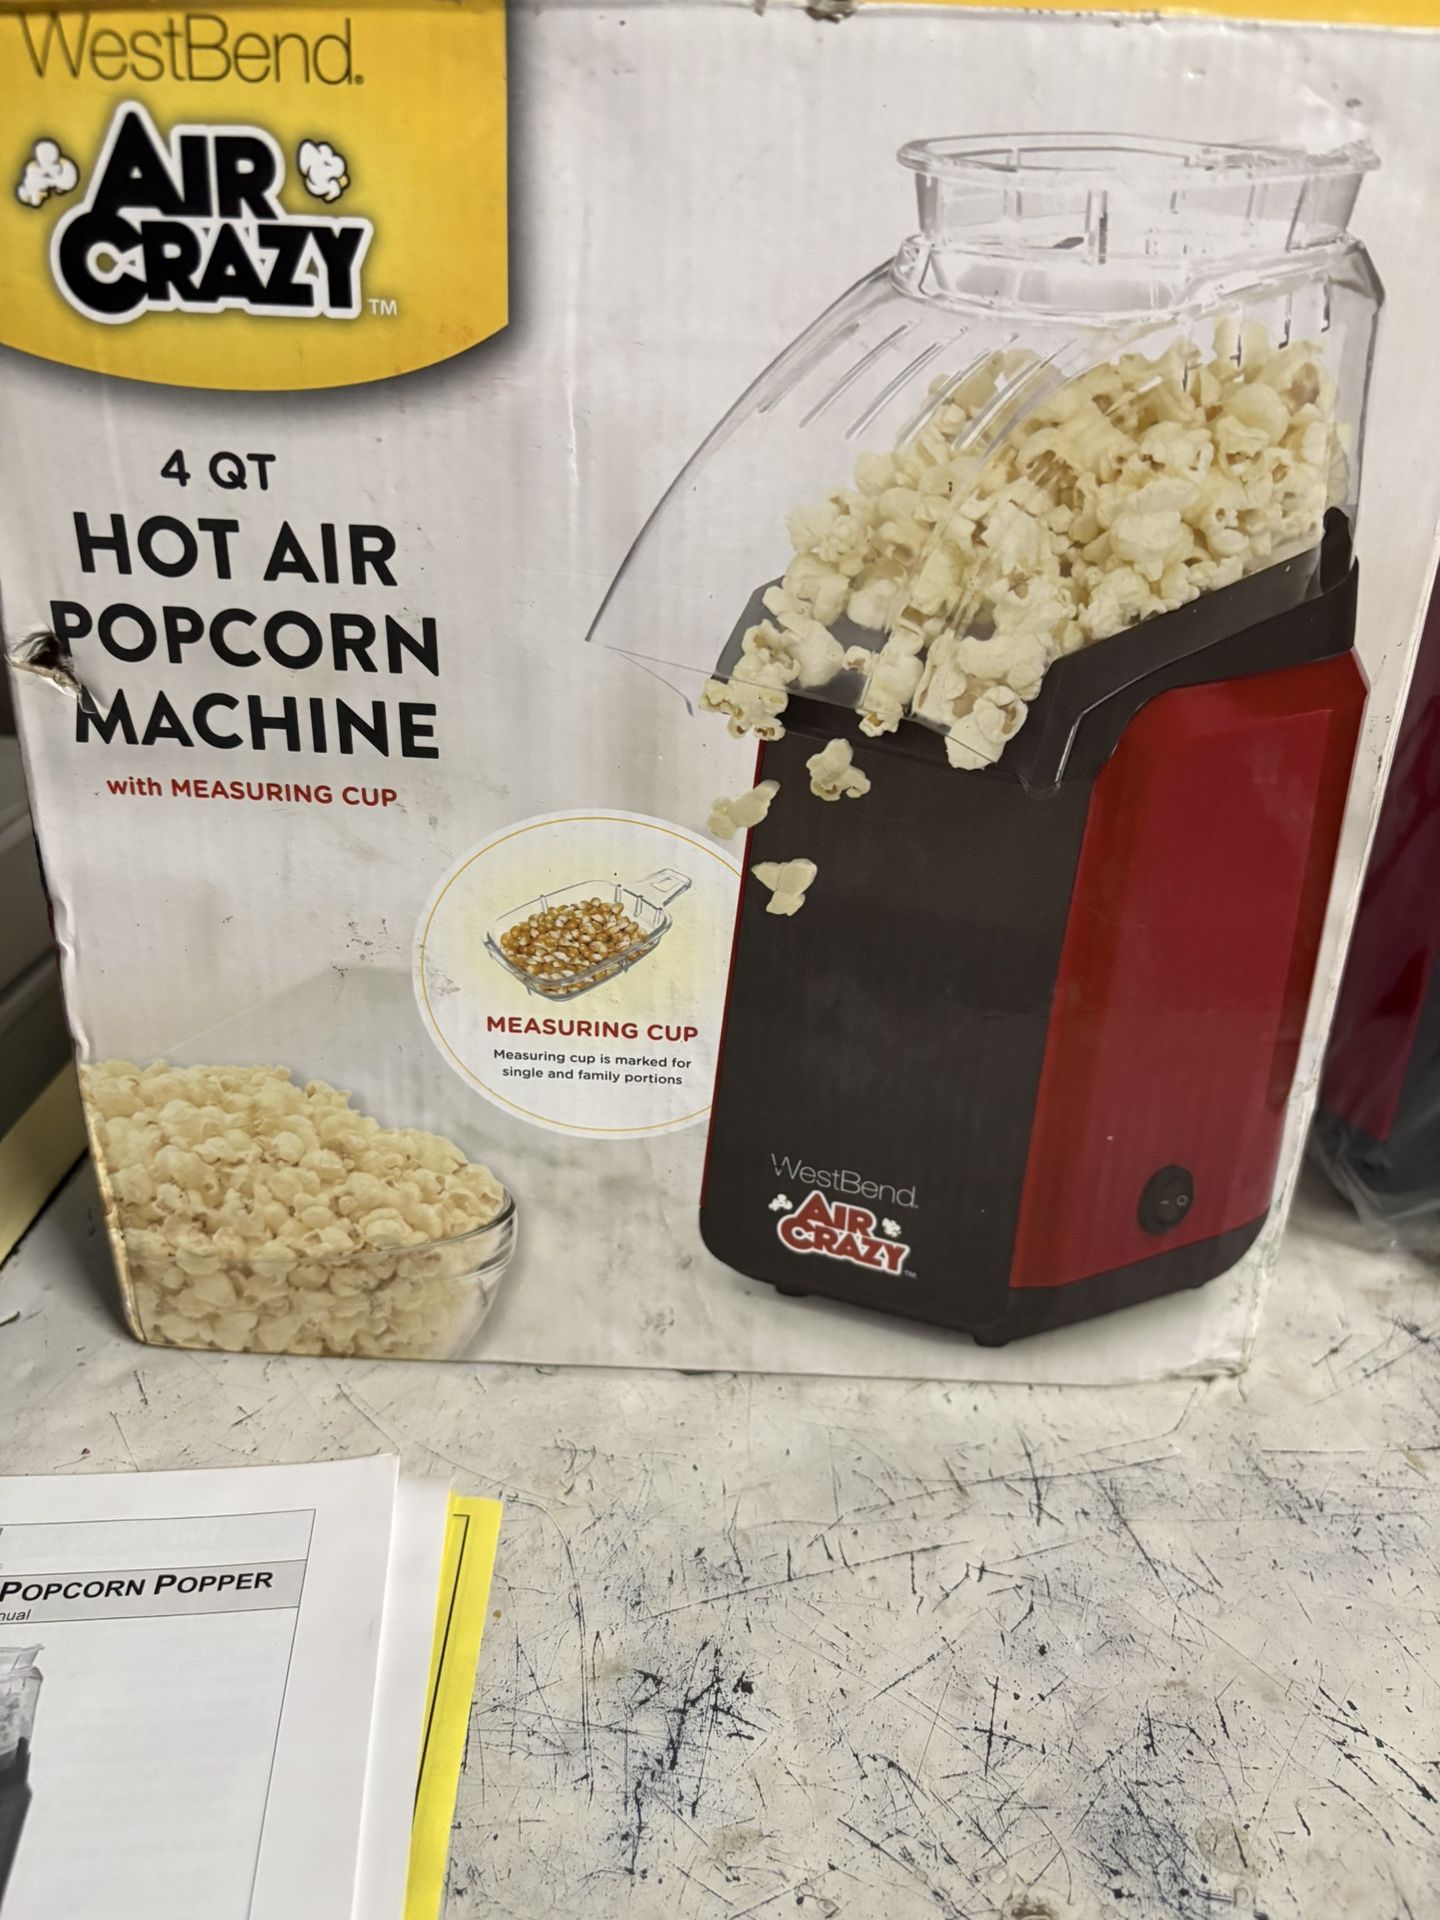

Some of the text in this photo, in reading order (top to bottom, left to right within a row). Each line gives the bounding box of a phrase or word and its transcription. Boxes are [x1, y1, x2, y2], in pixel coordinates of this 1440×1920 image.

[92, 108, 281, 221] AIR
[57, 209, 366, 316] CRAZY
[160, 448, 277, 490] 4 QT
[73, 510, 398, 587] HOT AIR
[50, 600, 440, 677] POPCORN
[75, 684, 440, 760] MACHINE
[106, 777, 398, 808] with MEASURING CUP
[486, 1015, 699, 1043] MEASURING CUP
[493, 1049, 692, 1069] Measuring cup is marked for
[502, 1066, 683, 1086] single and family portions
[801, 1191, 876, 1239] AIR
[779, 1215, 909, 1275] CRAZY
[0, 1571, 274, 1602] POPCORN POPPER
